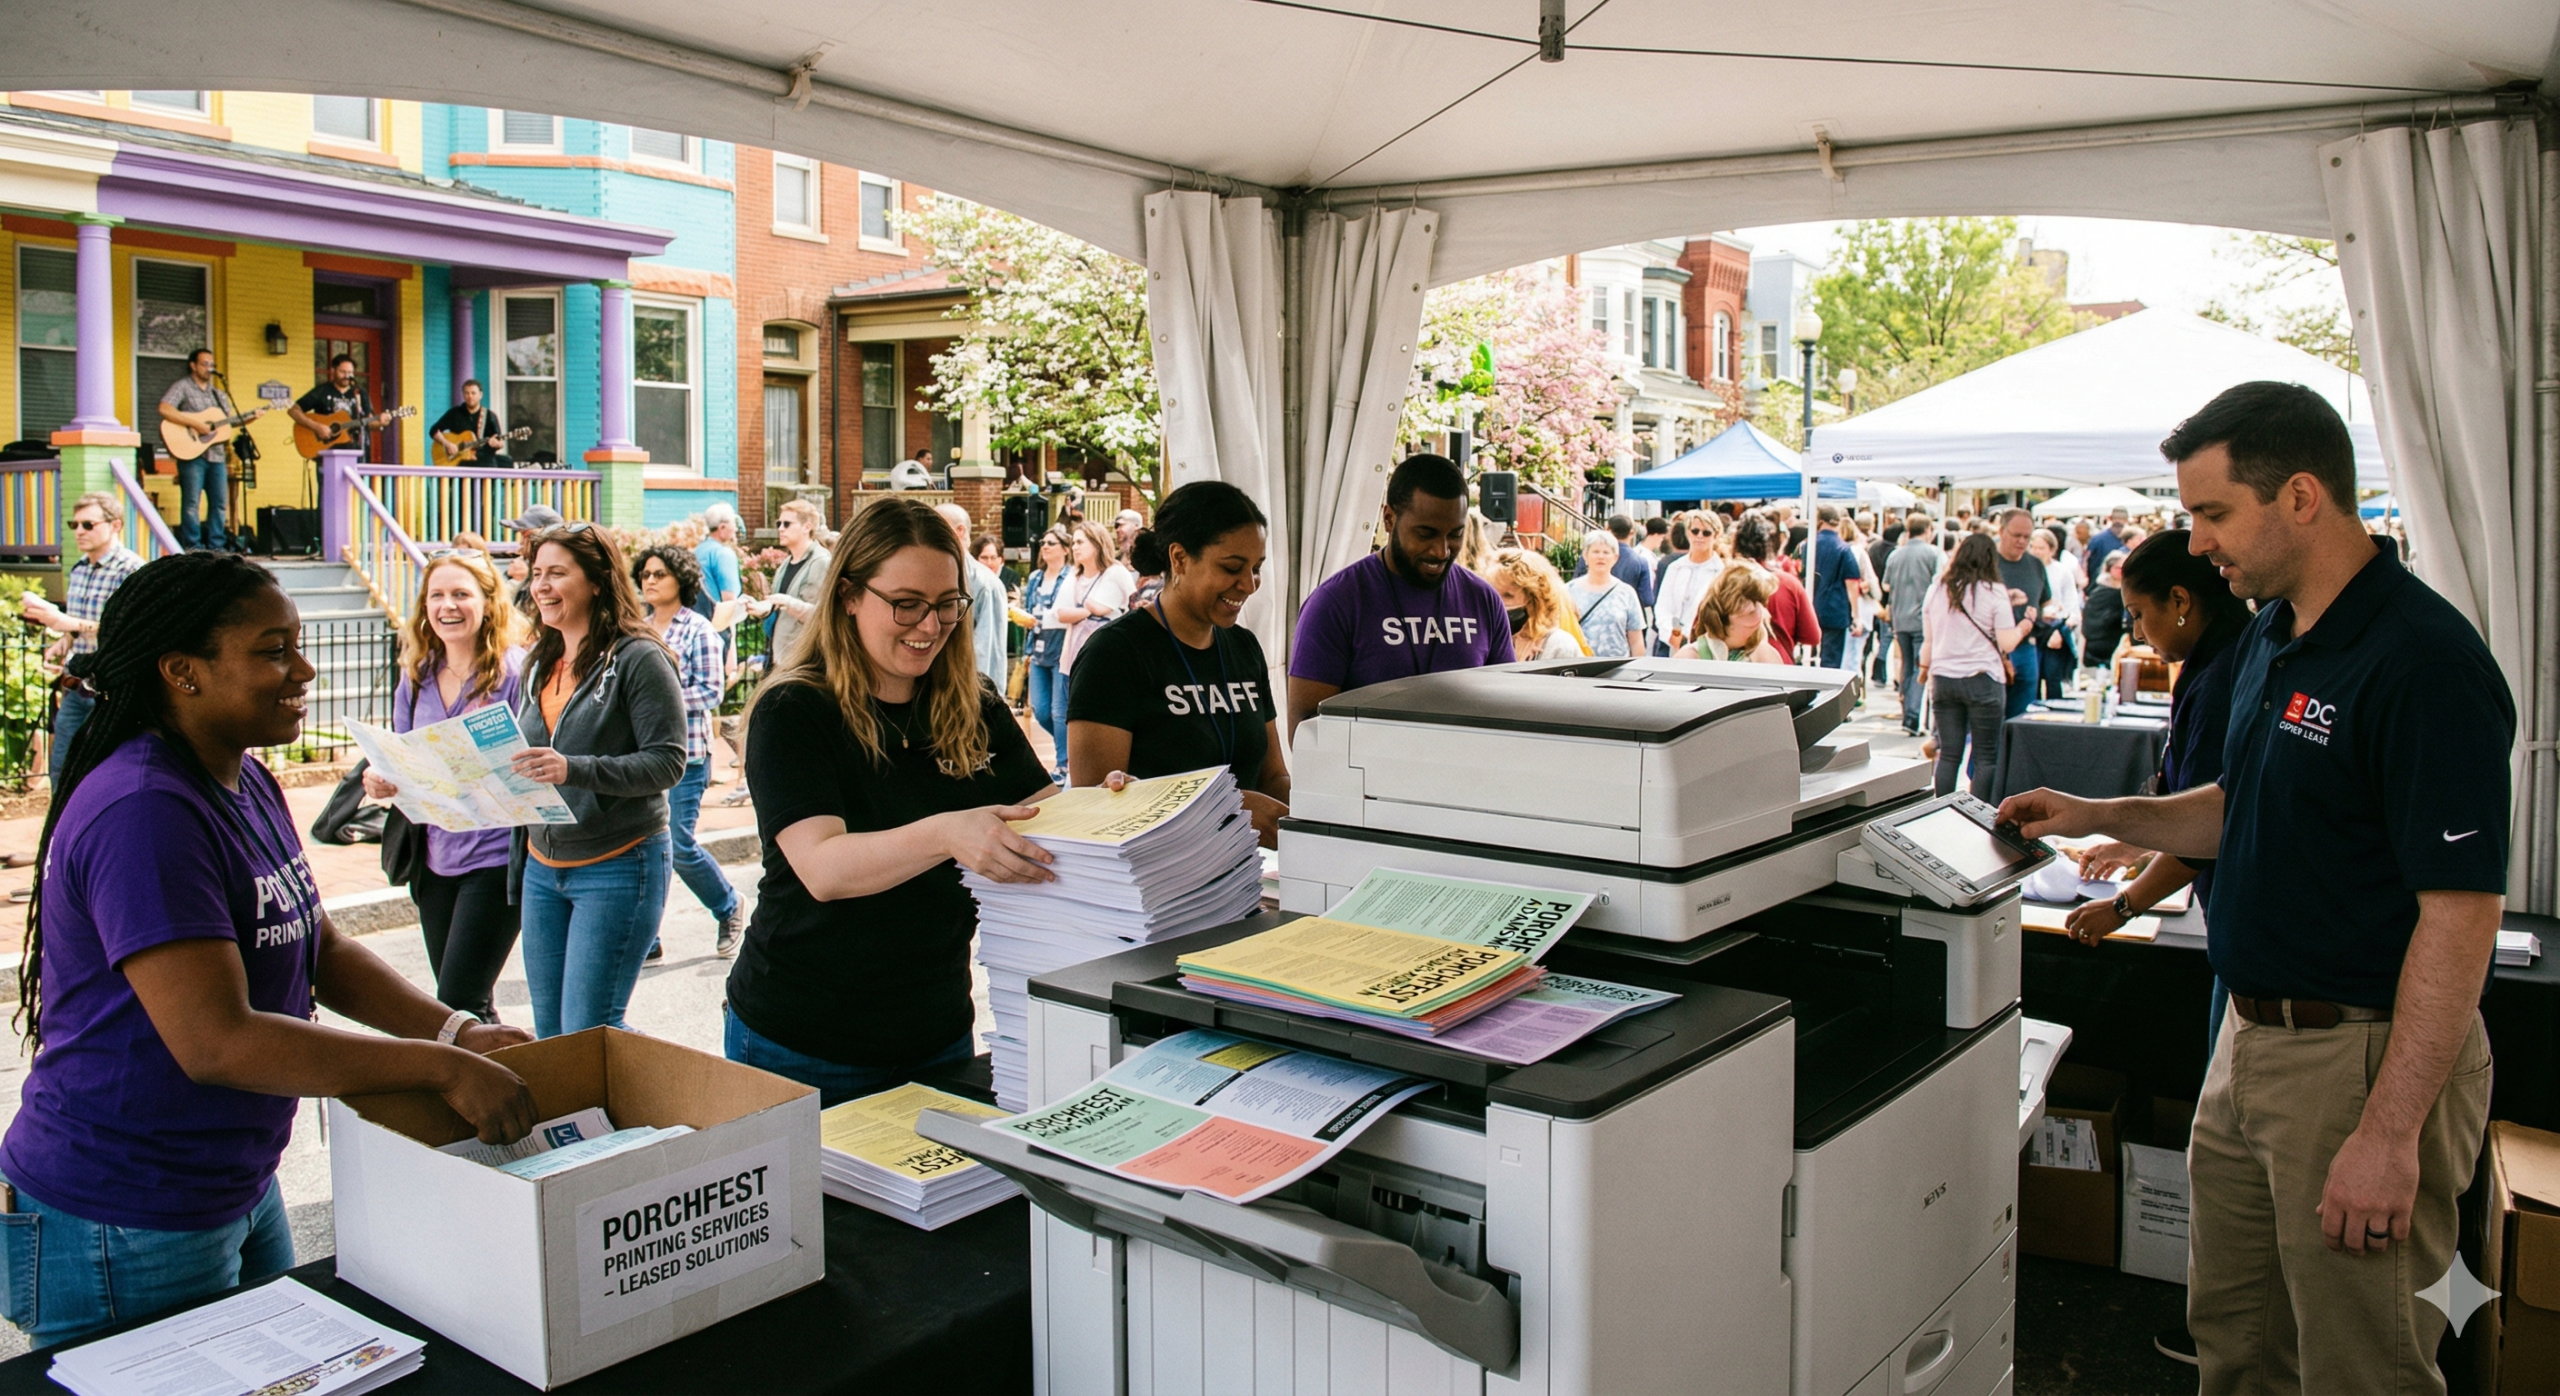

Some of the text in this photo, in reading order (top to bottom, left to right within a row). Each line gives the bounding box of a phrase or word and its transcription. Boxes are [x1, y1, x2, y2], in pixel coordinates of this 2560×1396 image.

[1382, 616, 1478, 646] STAFF
[1165, 681, 1259, 715] STAFF
[2303, 698, 2336, 726] DC
[2303, 730, 2329, 746] LEASE
[1378, 950, 1500, 1003] PORCHFEST
[1012, 1088, 1121, 1133] PORCHFEST
[603, 1165, 768, 1250] PORCHFEST
[604, 1201, 769, 1277] PRINTING SERVICES
[619, 1259, 681, 1296] LEASED
[685, 1226, 770, 1271] SOLUTIONS
